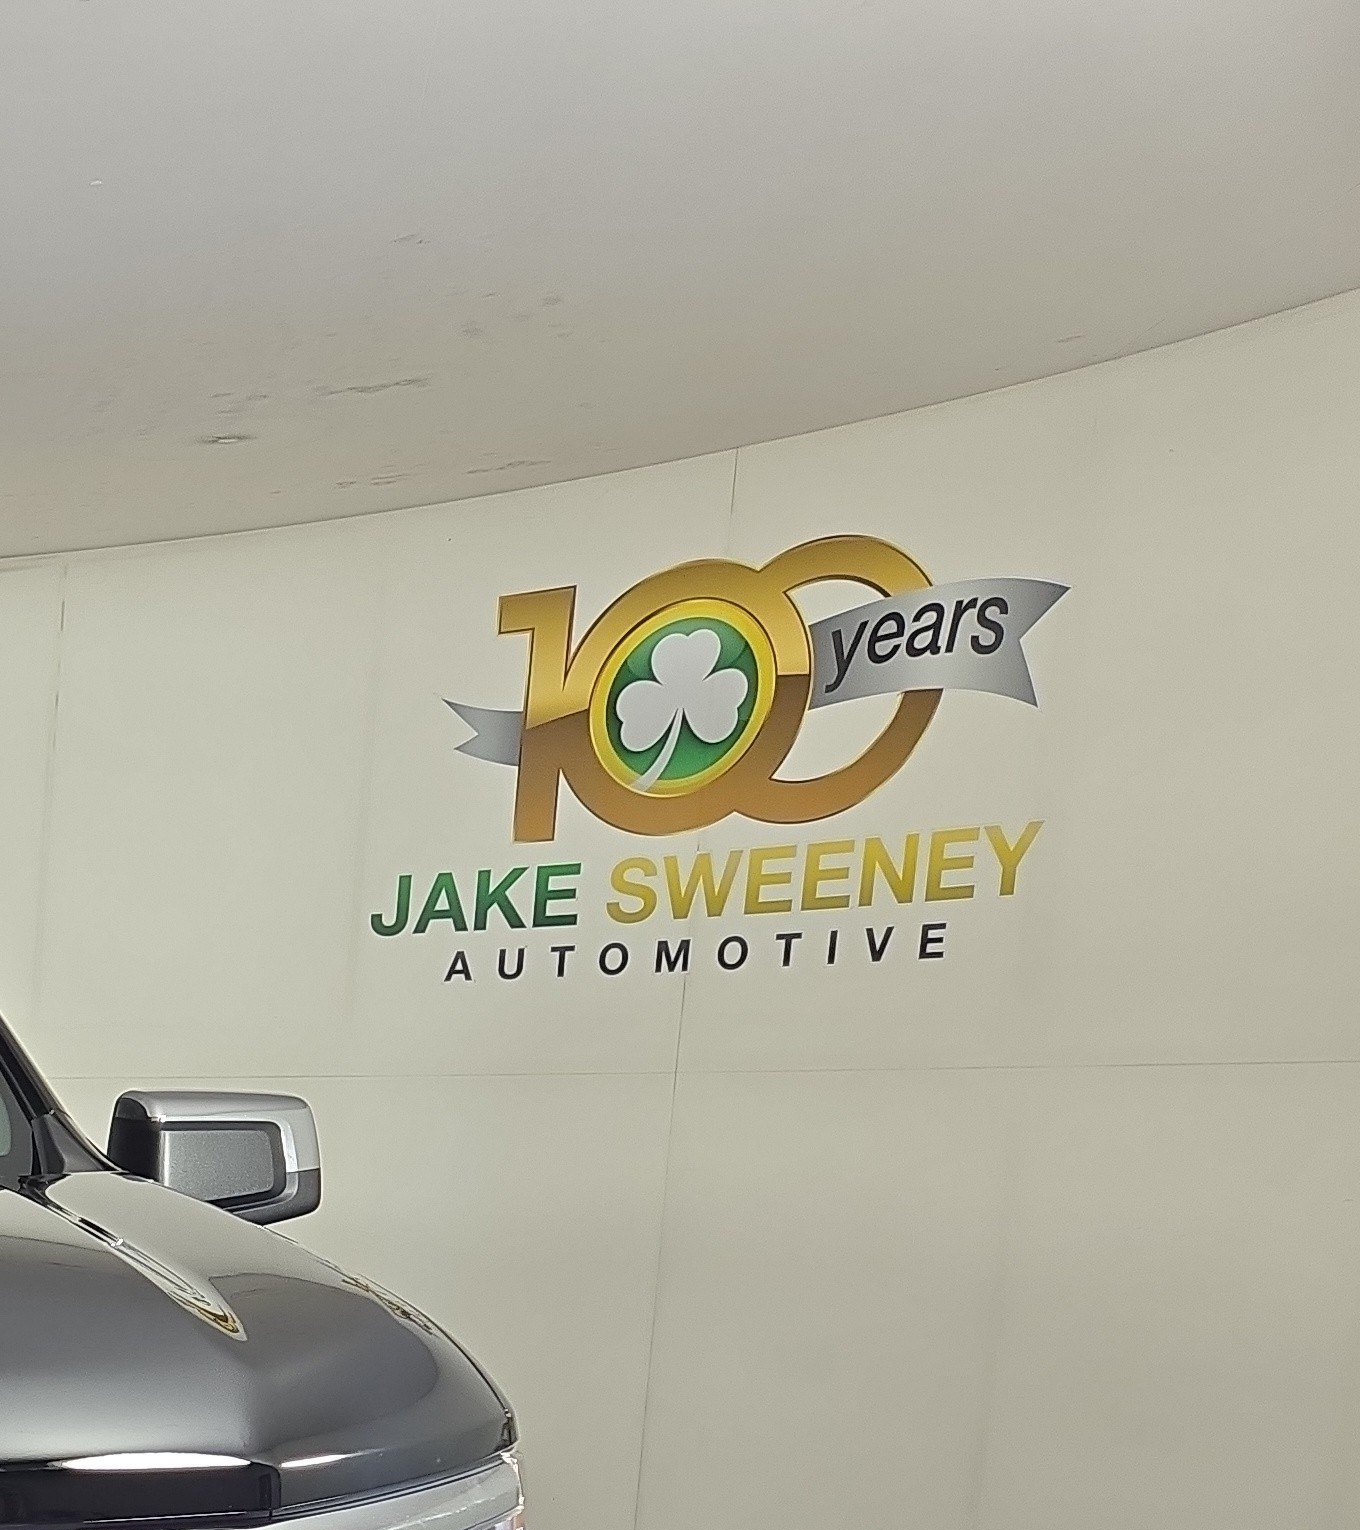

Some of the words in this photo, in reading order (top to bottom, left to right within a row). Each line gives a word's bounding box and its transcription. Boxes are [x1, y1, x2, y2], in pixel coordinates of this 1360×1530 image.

[498, 534, 944, 843] 100
[825, 594, 1009, 693] years
[370, 862, 583, 937] JAKE
[605, 820, 1045, 925] SWEENEY
[444, 922, 949, 982] AUTOMOTIVE
